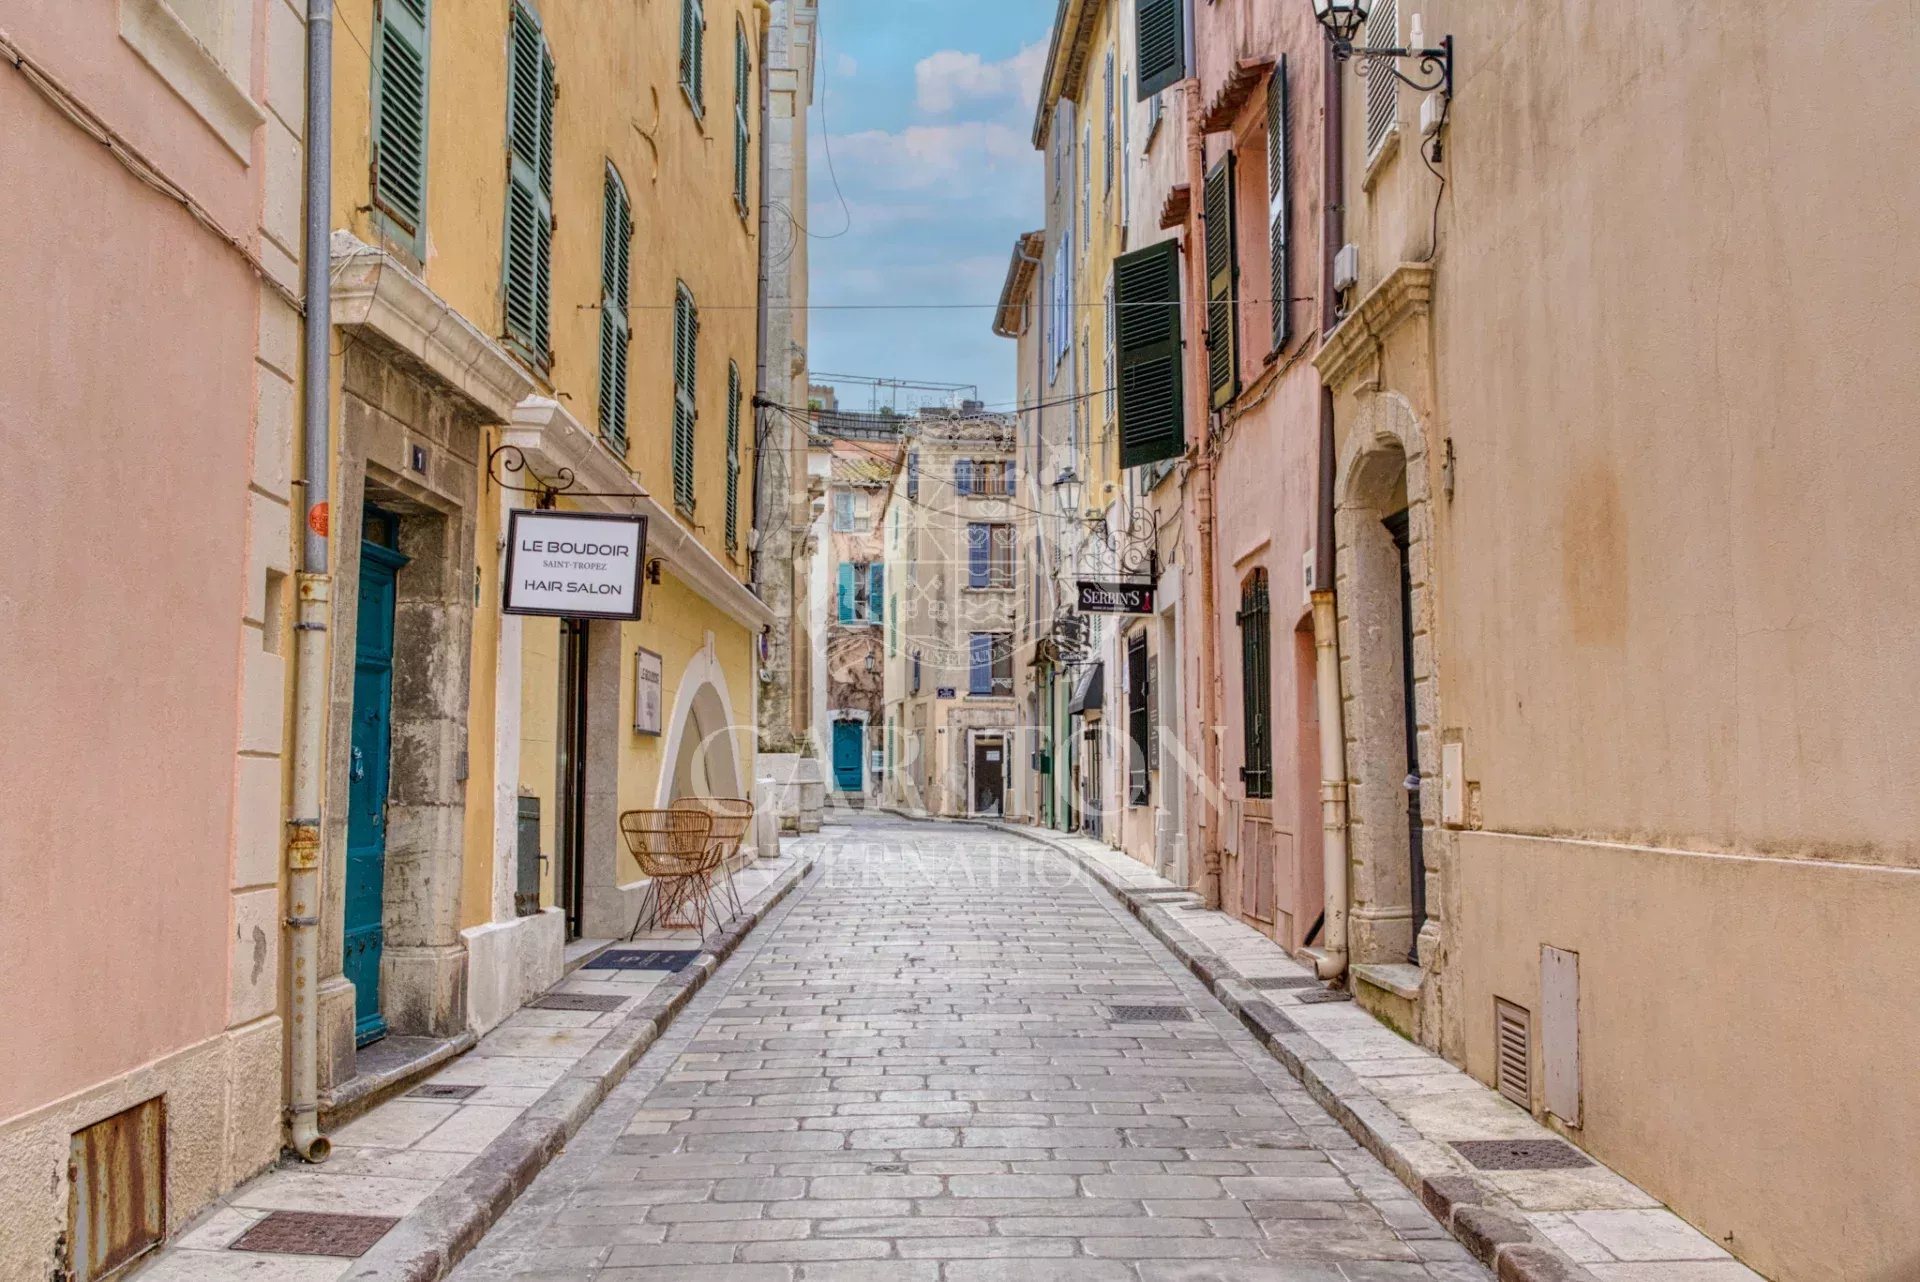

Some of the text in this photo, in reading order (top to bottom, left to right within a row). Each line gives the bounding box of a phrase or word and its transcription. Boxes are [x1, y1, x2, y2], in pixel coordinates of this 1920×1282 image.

[416, 452, 422, 469] 1
[522, 540, 629, 557] LE BOUDOIR
[543, 559, 608, 571] SAINT-TROPEZ
[525, 580, 622, 595] HAIR SALON
